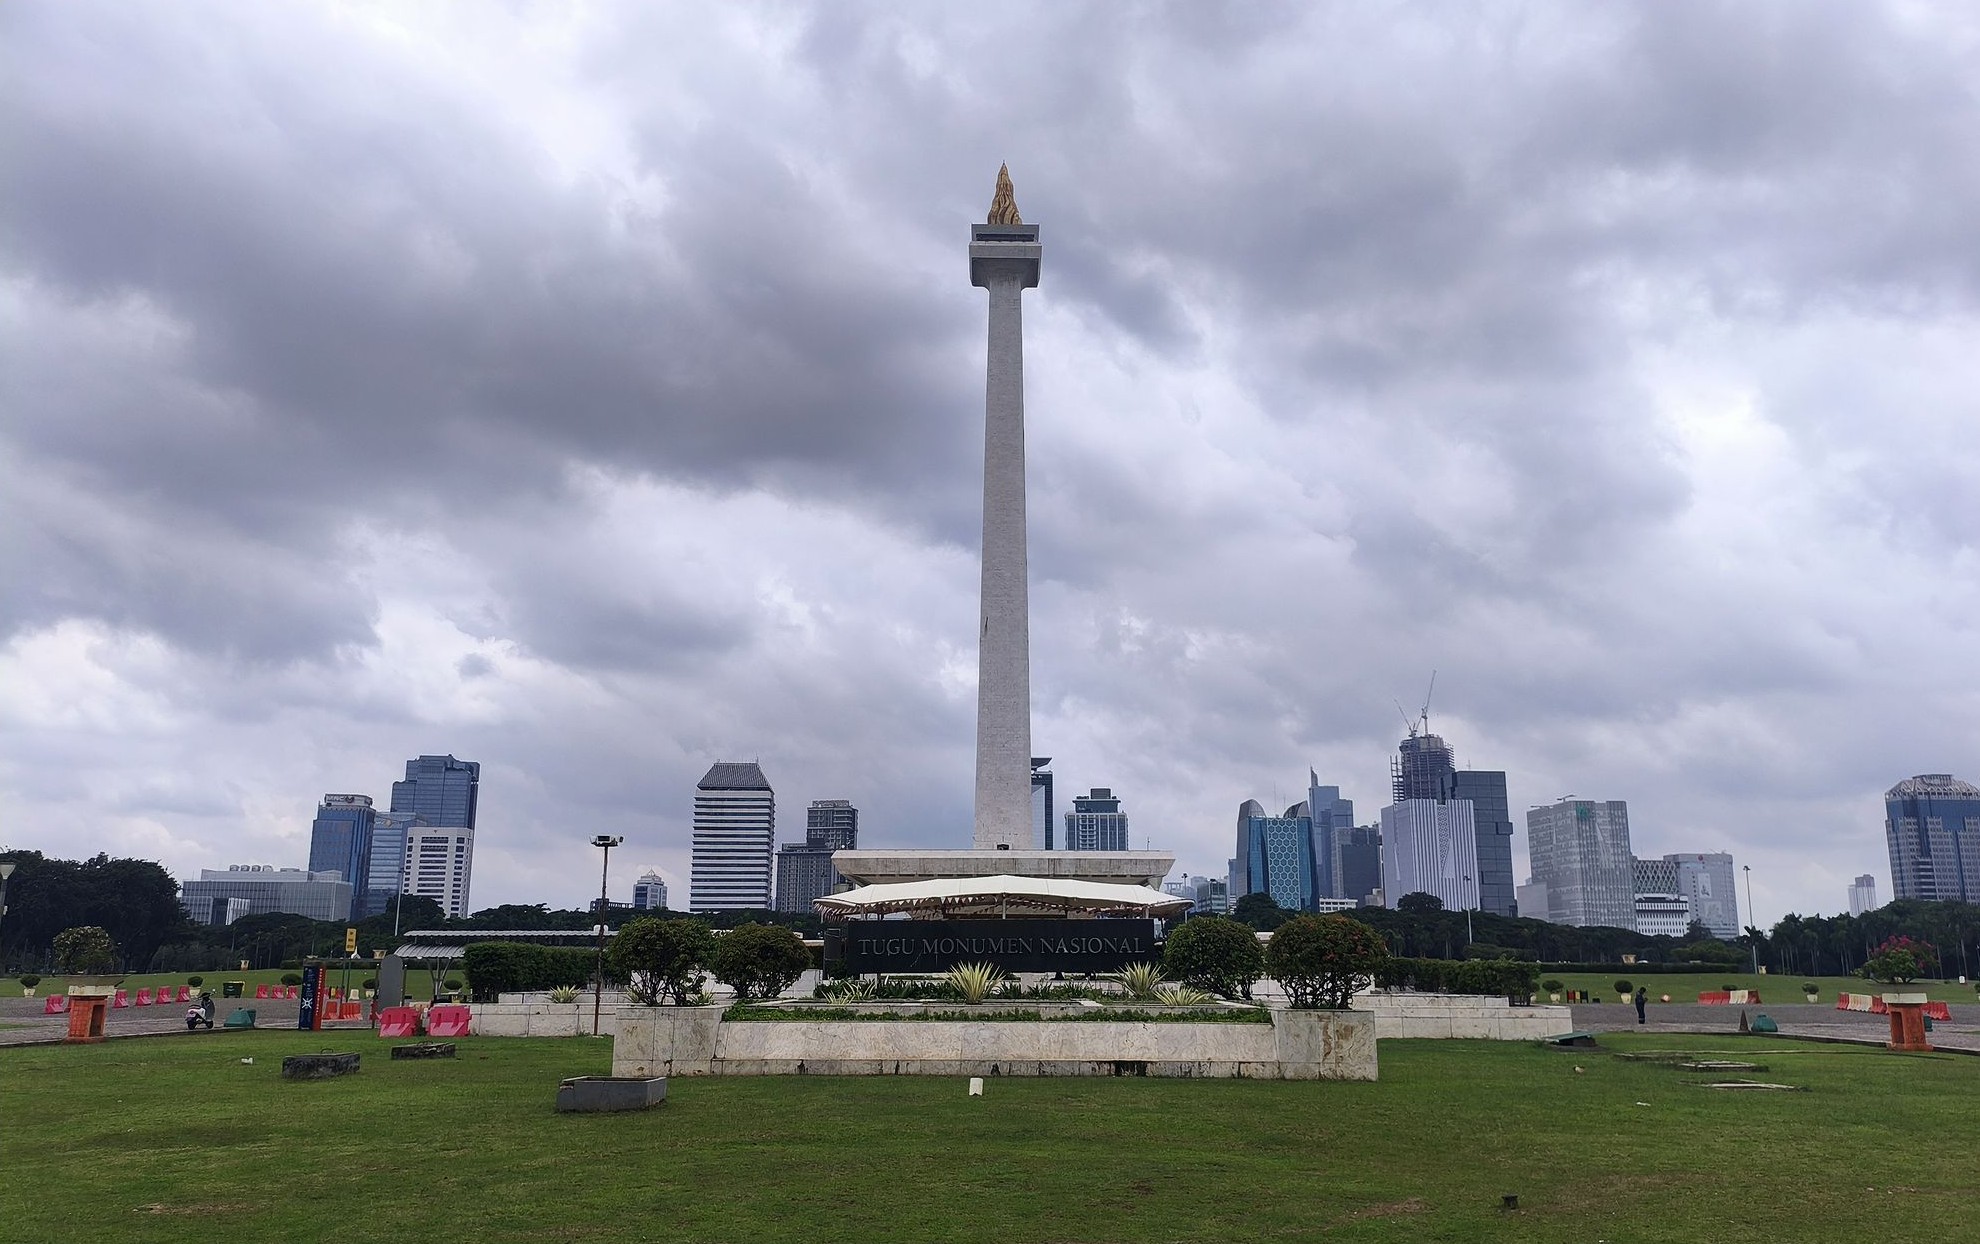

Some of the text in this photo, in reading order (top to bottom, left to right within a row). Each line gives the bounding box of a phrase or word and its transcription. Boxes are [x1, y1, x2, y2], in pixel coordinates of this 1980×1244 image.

[858, 937, 1146, 955] TUGU MONUMEN NASIONAL
